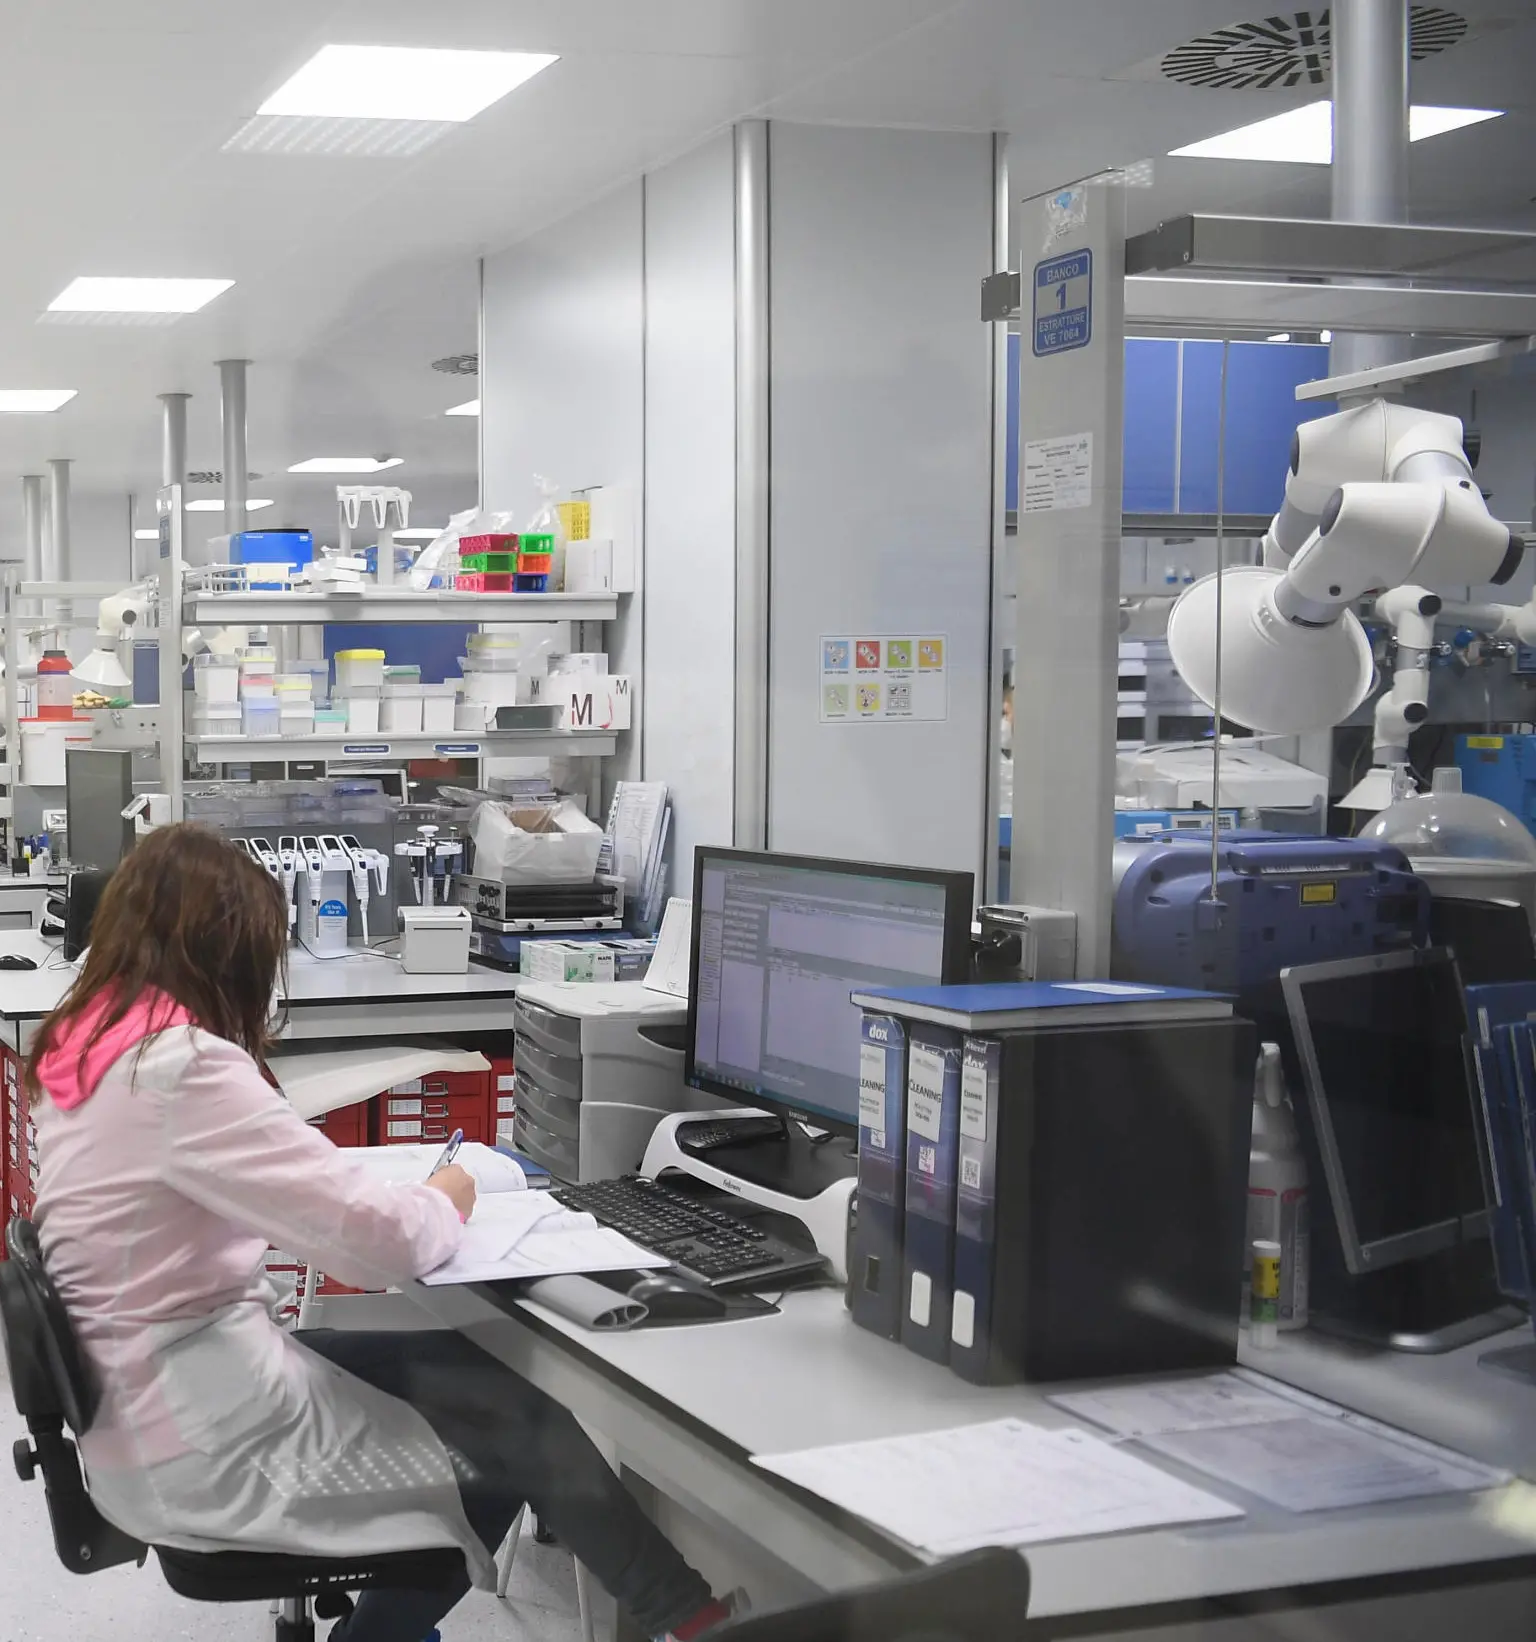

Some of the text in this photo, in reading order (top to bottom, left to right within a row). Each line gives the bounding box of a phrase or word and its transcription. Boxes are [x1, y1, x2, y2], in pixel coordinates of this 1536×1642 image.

[1047, 263, 1079, 282] BANCO
[1056, 283, 1066, 310] 1
[1039, 312, 1084, 333] ESTRATTORE
[1045, 333, 1057, 346] VE
[869, 1024, 889, 1041] dox
[860, 1078, 886, 1093] LEANING
[908, 1079, 942, 1104] CLEANING
